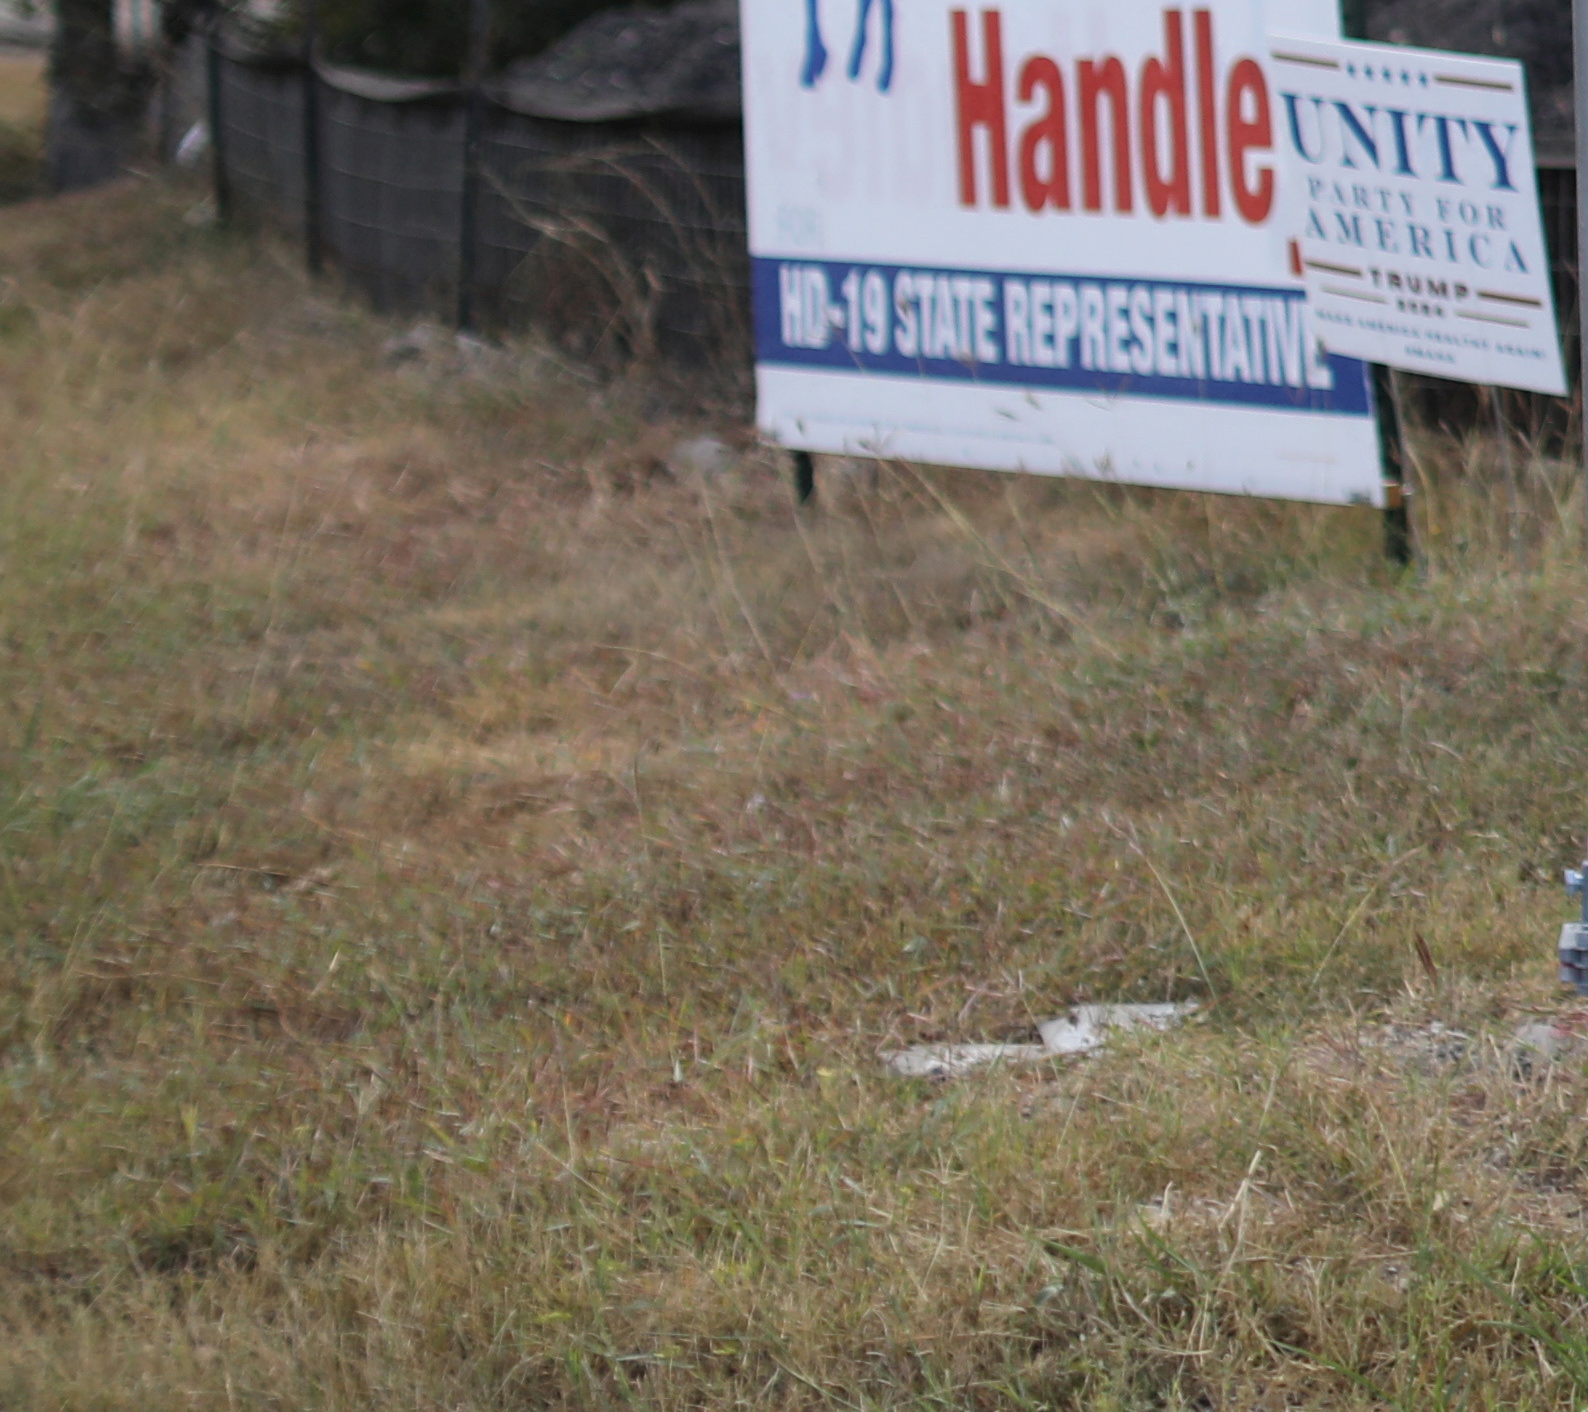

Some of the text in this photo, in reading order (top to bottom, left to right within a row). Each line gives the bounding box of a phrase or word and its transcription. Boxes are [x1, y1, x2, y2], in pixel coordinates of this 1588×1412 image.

[950, 8, 1302, 275] Handle
[1278, 91, 1519, 193] UNITY
[1305, 208, 1530, 275] AMERICA
[1307, 175, 1508, 231] PARTY FOR
[779, 264, 889, 355] HD-19
[894, 270, 1000, 364] STATE
[1370, 268, 1470, 299] TRUMP
